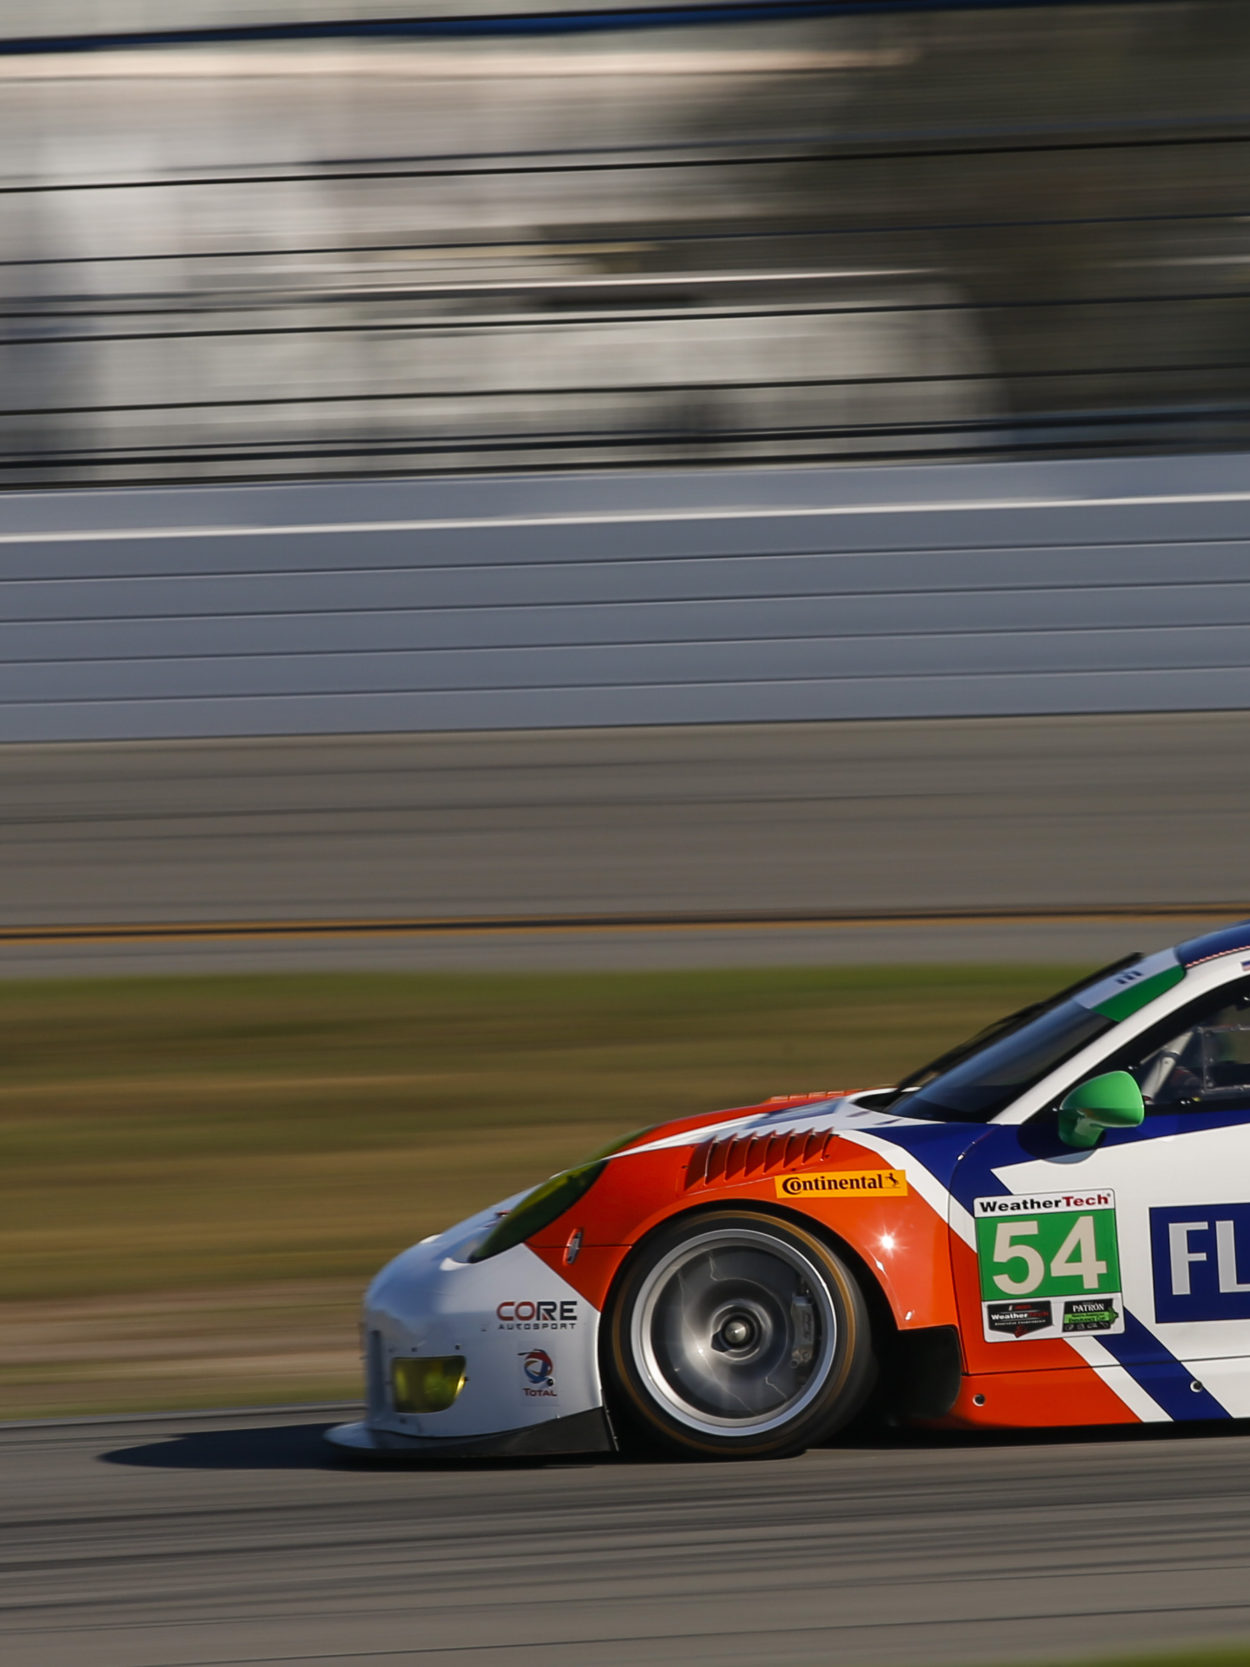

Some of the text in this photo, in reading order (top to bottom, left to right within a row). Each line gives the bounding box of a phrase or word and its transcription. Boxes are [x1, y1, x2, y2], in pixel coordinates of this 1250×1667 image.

[782, 1174, 883, 1195] Continental
[992, 1215, 1108, 1295] 54
[496, 1301, 578, 1321] CORE
[498, 1322, 577, 1331] AUTOSPORT
